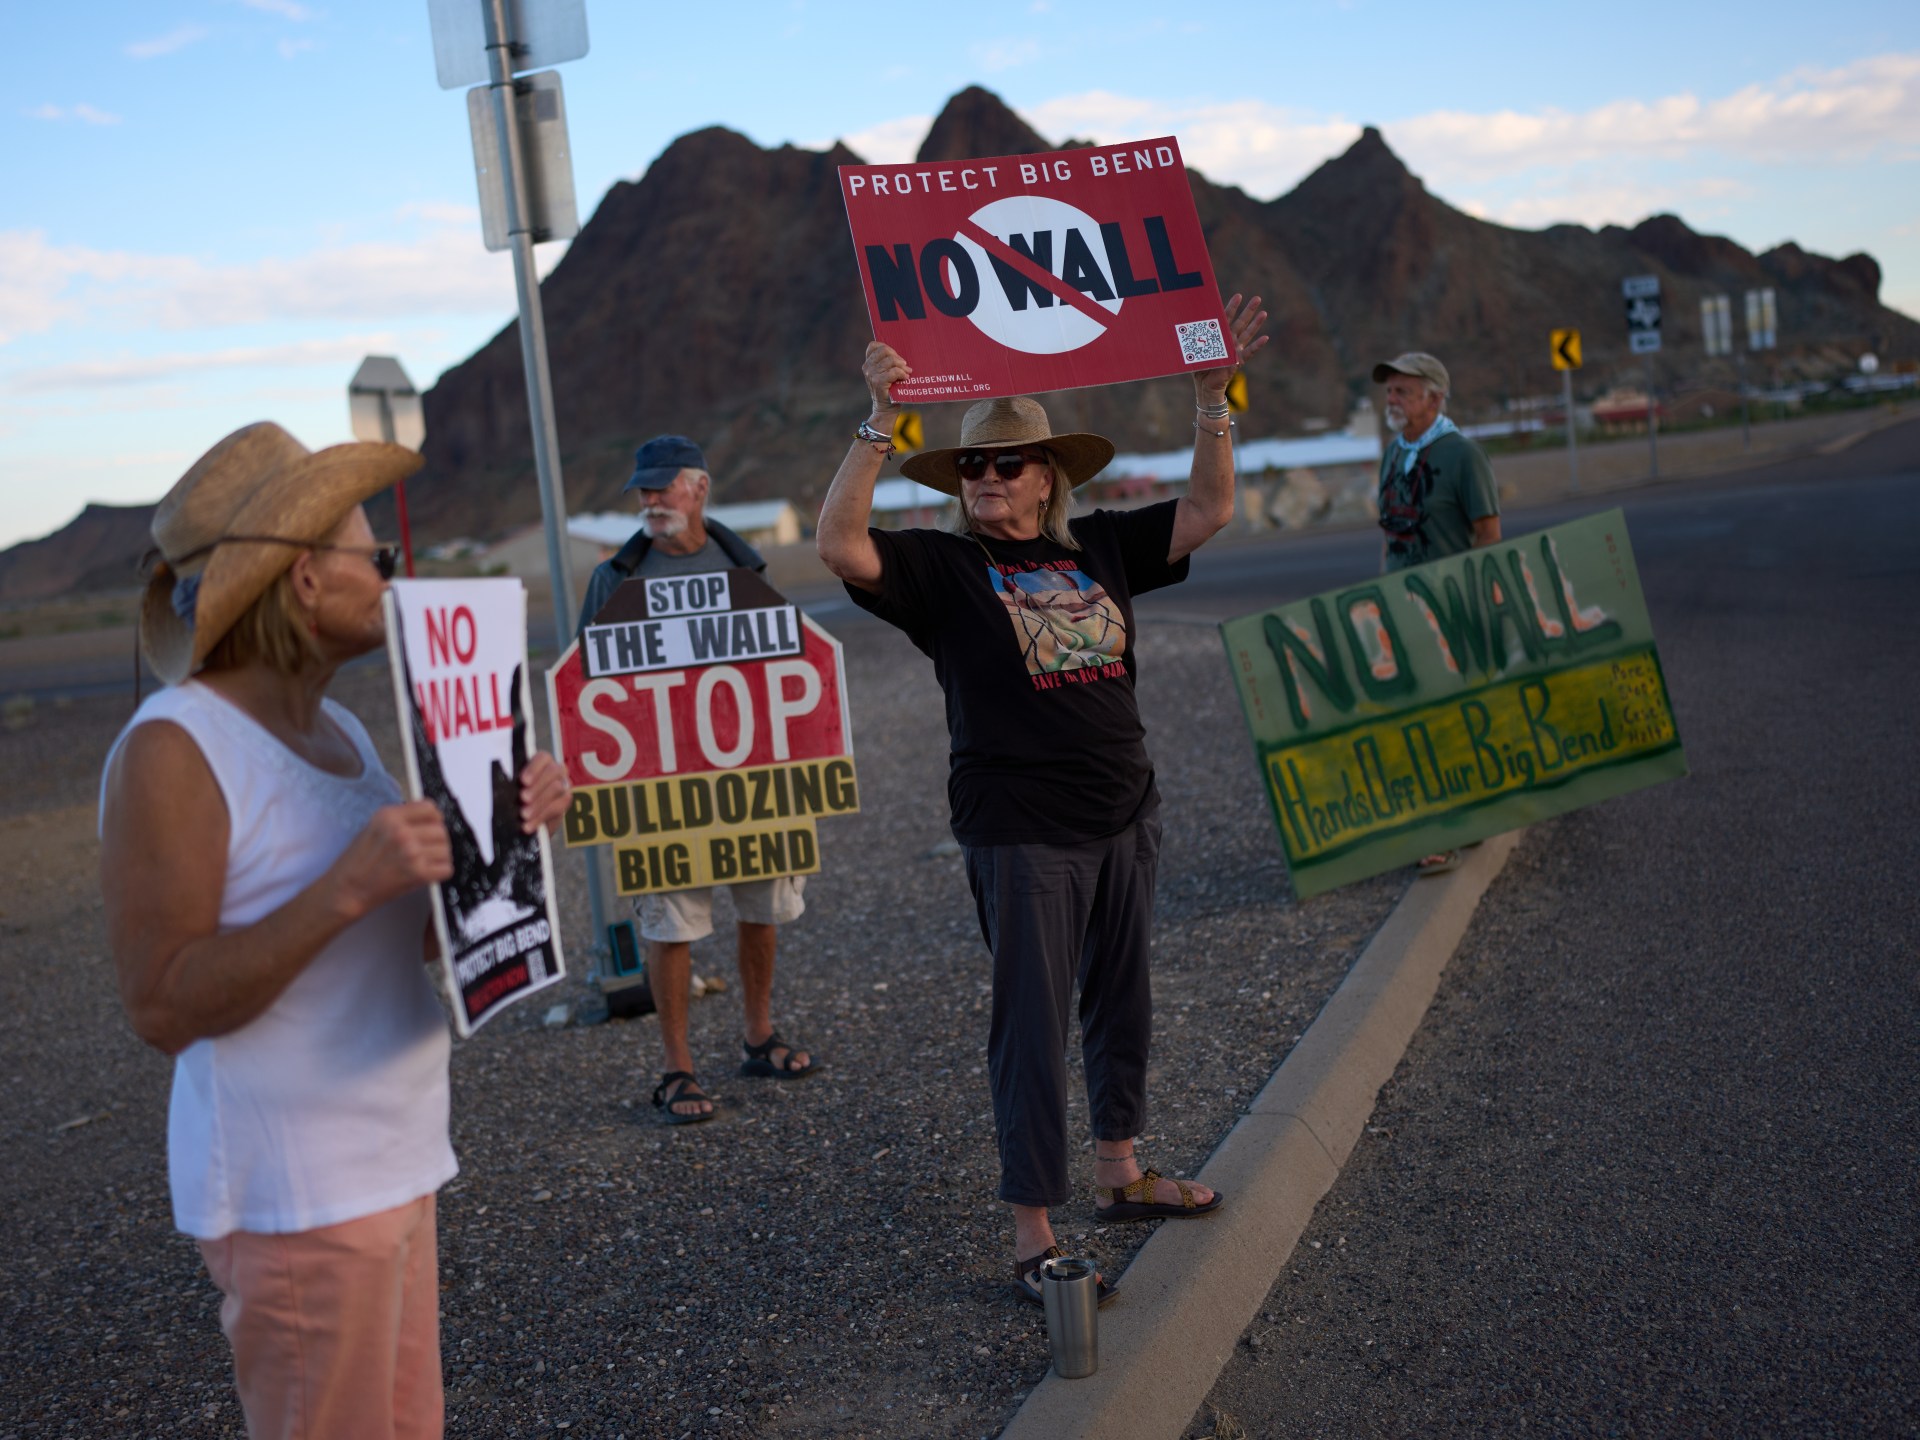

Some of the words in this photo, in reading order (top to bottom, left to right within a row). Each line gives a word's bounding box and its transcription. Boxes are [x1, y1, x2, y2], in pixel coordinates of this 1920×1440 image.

[849, 167, 998, 196] PROTECT
[1020, 160, 1072, 185] BIG
[1090, 146, 1175, 177] BEND
[865, 238, 980, 322] NO
[984, 216, 1204, 312] WALL
[895, 374, 972, 385] NOBIGBENDWALL
[897, 384, 991, 396] NOBIGBENDWALL.ORG
[649, 576, 725, 613] STOP
[424, 605, 477, 667] NO
[589, 622, 667, 671] THE
[687, 609, 796, 660] WALL
[1263, 586, 1417, 731] NO
[1404, 535, 1623, 674] WALL
[417, 672, 514, 745] WALL
[1031, 672, 1062, 691] SAVE
[1078, 666, 1098, 685] RIO
[578, 659, 822, 781] STOP
[1271, 757, 1369, 852] Hands
[1402, 720, 1475, 801] Our
[1461, 702, 1536, 788] Big
[1519, 678, 1616, 772] Bend
[564, 760, 857, 844] BULLDOZING
[618, 843, 692, 891] BIG
[709, 828, 816, 881] BEND
[494, 932, 518, 963] BIG
[515, 918, 551, 953] BEND
